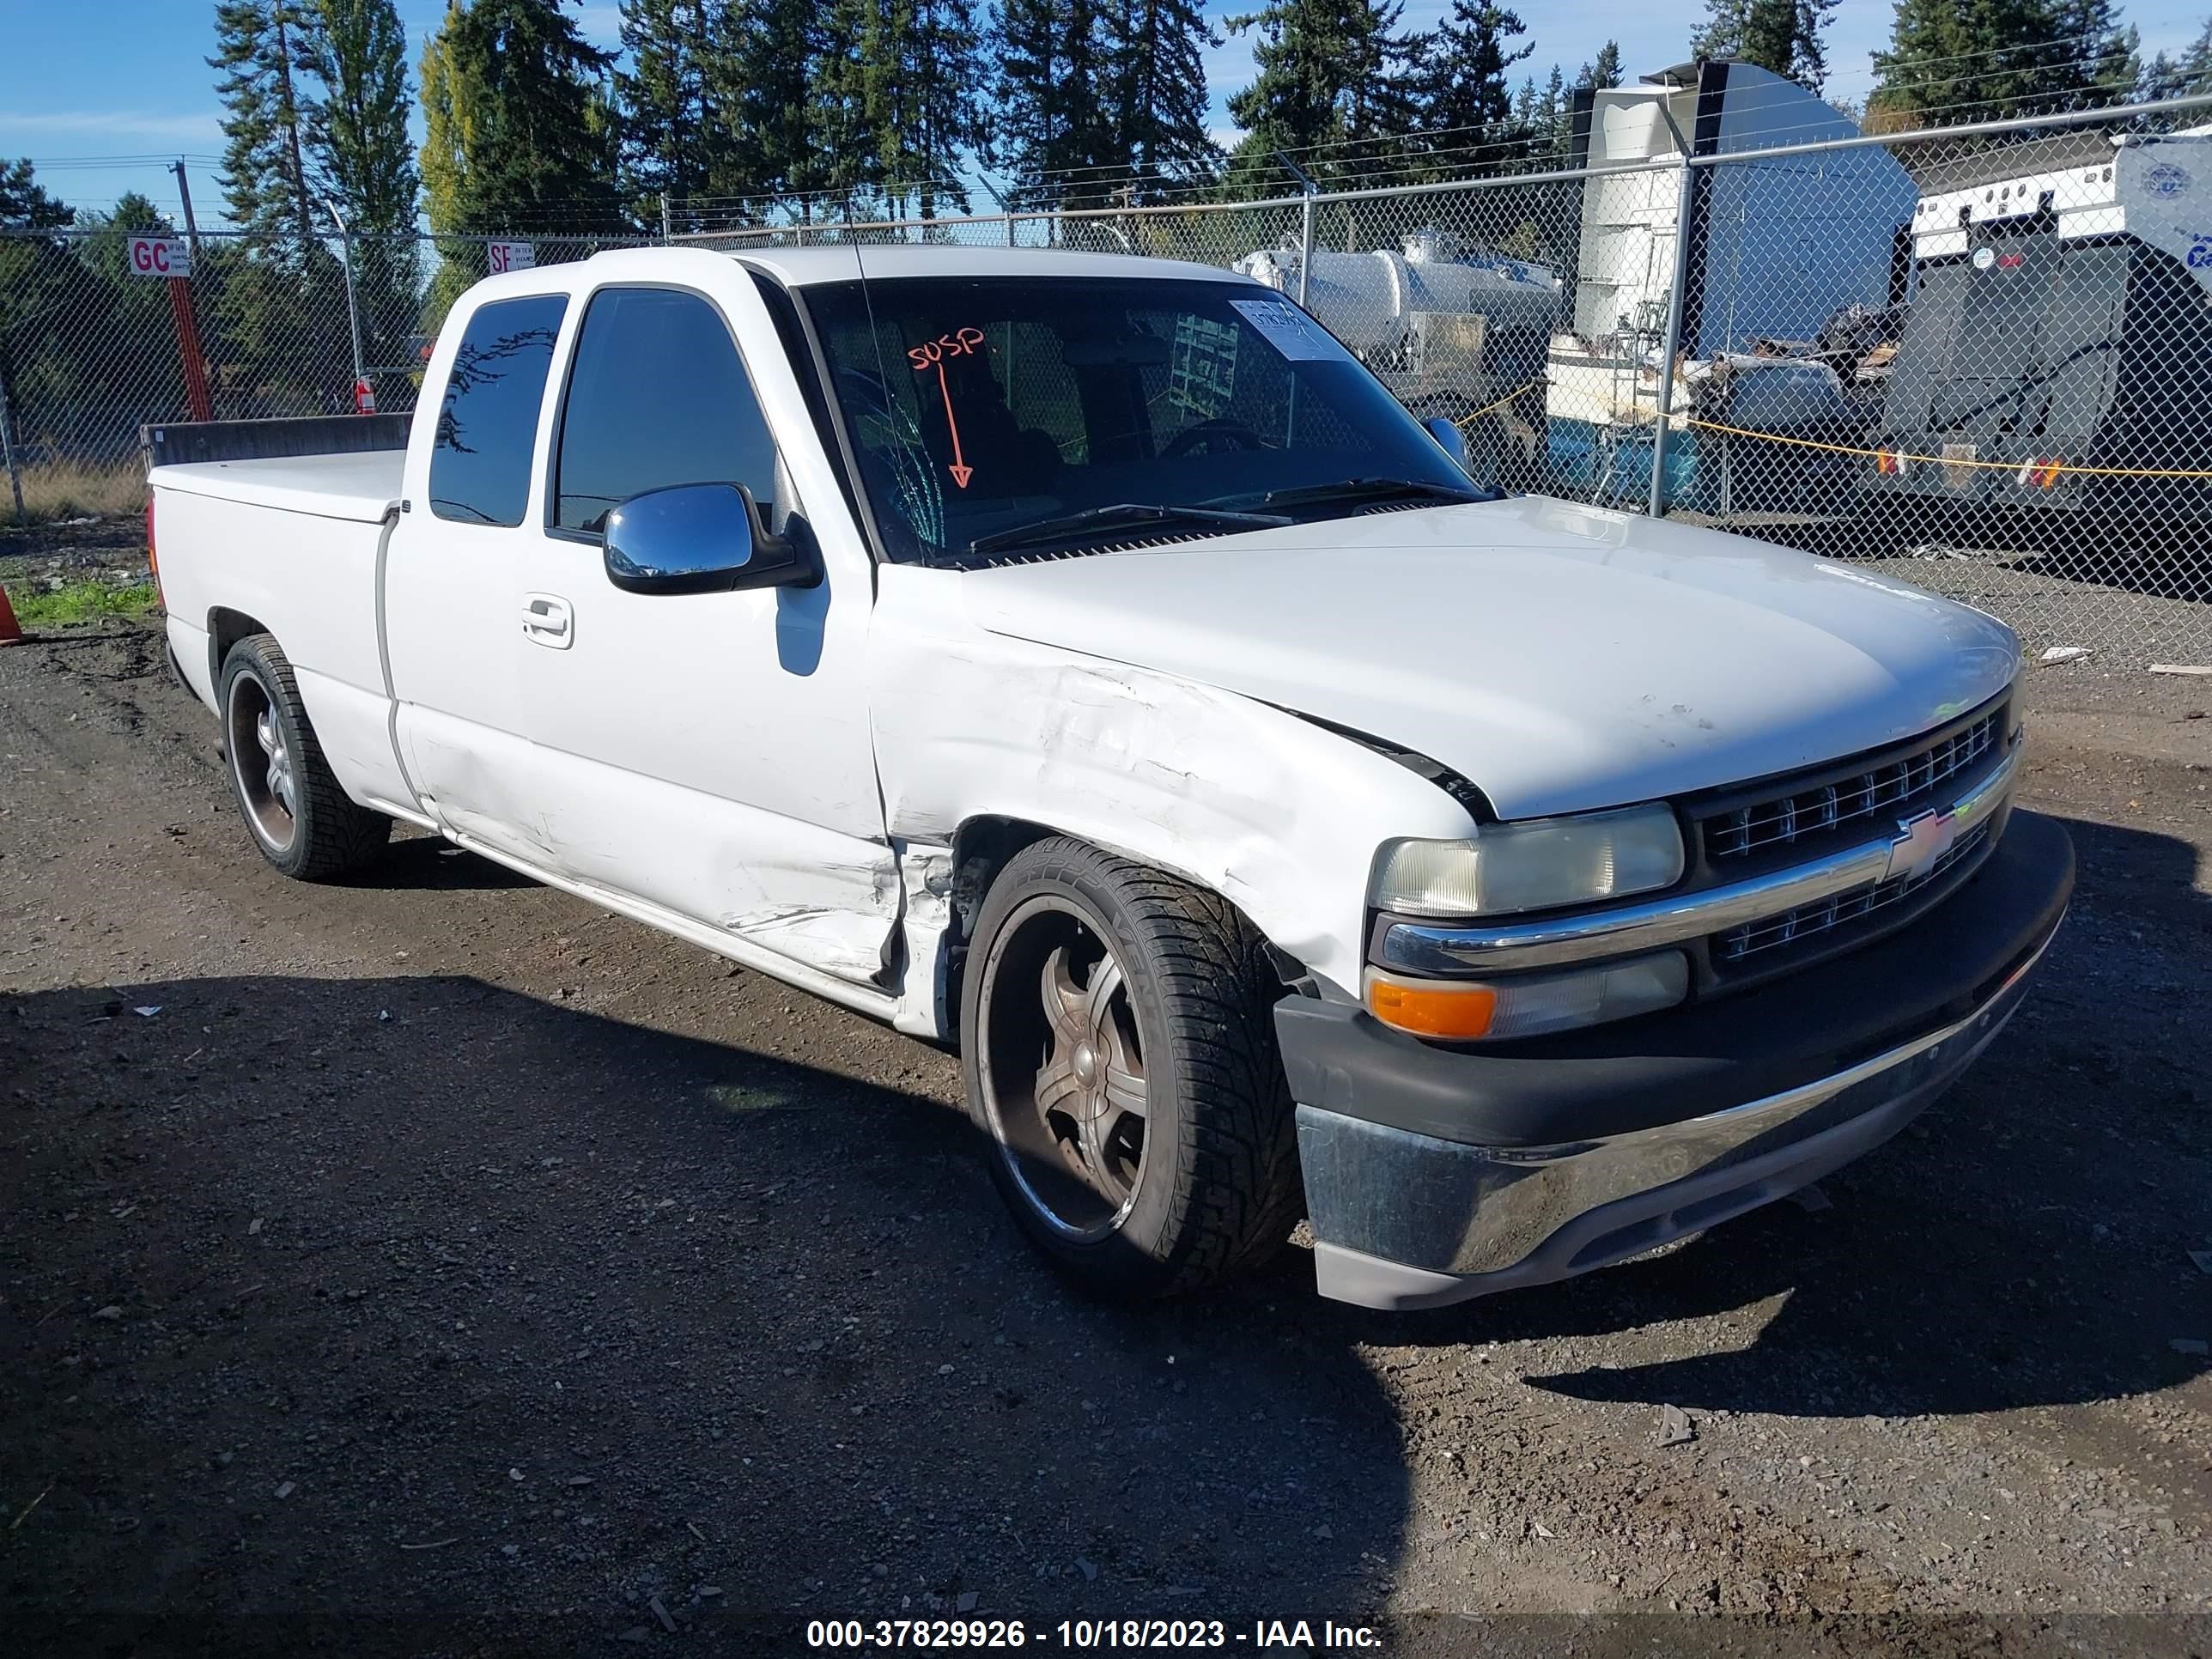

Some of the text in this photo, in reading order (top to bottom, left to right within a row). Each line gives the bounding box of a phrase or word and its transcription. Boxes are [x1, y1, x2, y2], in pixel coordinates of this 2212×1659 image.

[134, 241, 169, 272] GC
[491, 246, 511, 272] SF
[908, 328, 984, 369] SUSP
